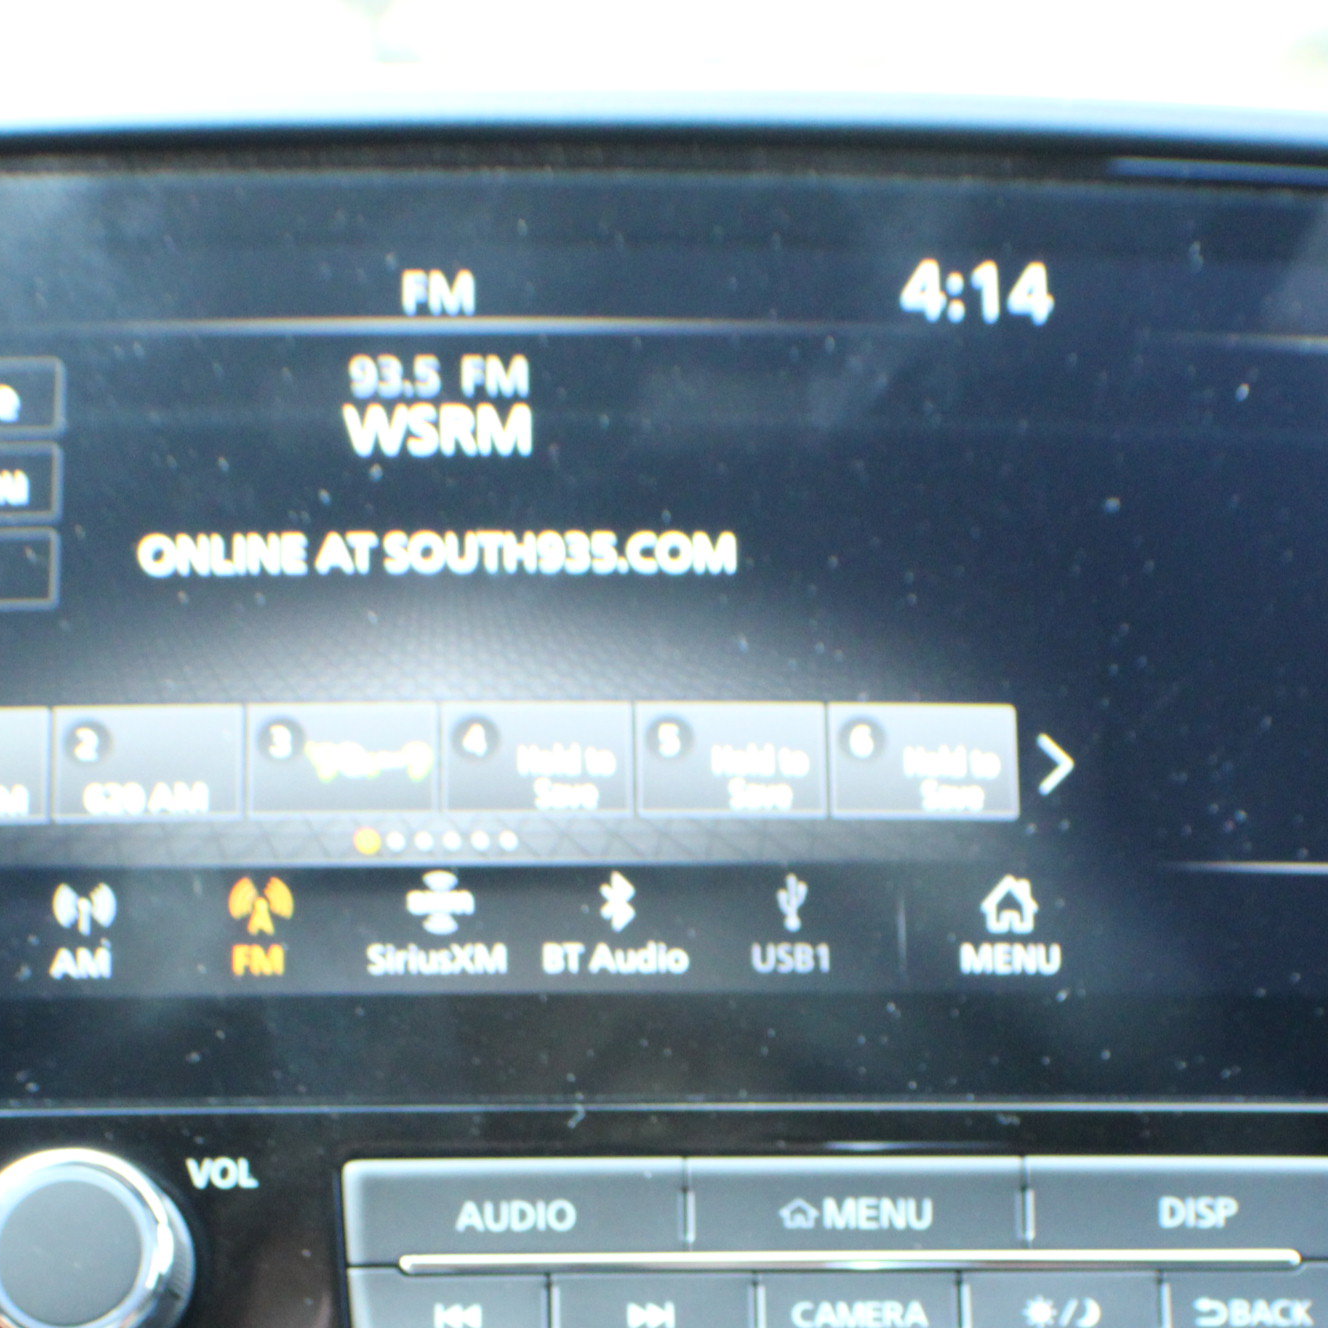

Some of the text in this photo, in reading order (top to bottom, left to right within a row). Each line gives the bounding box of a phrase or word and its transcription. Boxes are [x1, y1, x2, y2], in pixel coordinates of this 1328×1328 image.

[401, 269, 475, 316] FM
[899, 258, 1054, 325] 4:14
[348, 355, 530, 399] 93.5 FM
[344, 402, 533, 457] WSRM
[137, 529, 737, 578] ONLINE AT SOUTH935.COM
[74, 726, 100, 763] 2
[267, 724, 292, 760] 3
[464, 723, 487, 757] 4
[658, 721, 681, 758] 5
[147, 781, 209, 816] AM
[50, 948, 112, 979] AM
[232, 943, 284, 976] FM
[366, 942, 508, 976] SiriusXM
[542, 941, 689, 975] BT Audio
[751, 943, 830, 974] USB1
[959, 943, 1061, 975] MENU
[186, 1157, 258, 1190] VOL
[456, 1200, 576, 1233] AUDIO
[822, 1197, 932, 1232] MENU
[1159, 1197, 1238, 1230] DISP
[1228, 1297, 1313, 1328] BACK
